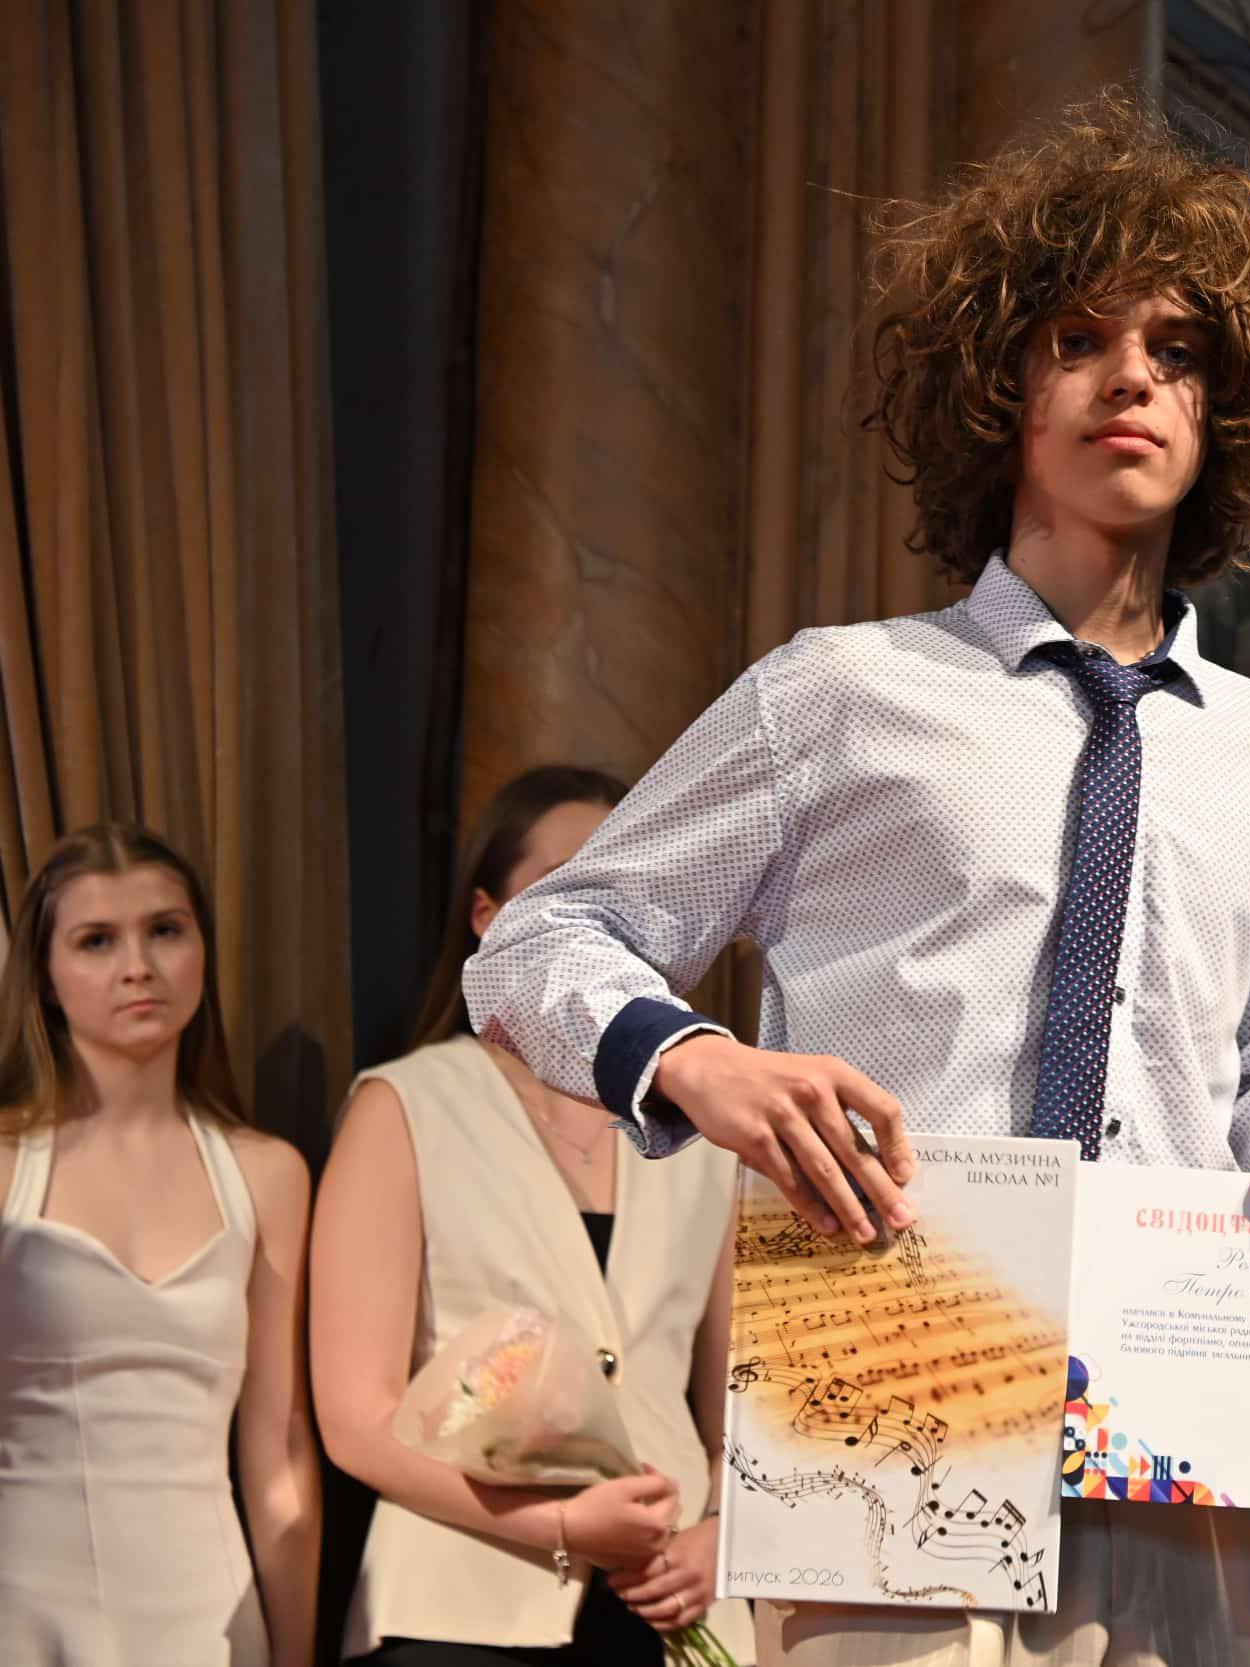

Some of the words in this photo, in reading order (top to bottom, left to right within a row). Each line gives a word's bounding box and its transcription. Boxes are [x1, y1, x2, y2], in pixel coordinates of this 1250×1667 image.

[980, 1151, 1062, 1168] МУЗИЧНА
[967, 1170, 1028, 1186] ШКОЛА
[1035, 1171, 1060, 1188] №1
[1177, 1309, 1247, 1324] Комунальному
[789, 1567, 845, 1586] 2026
